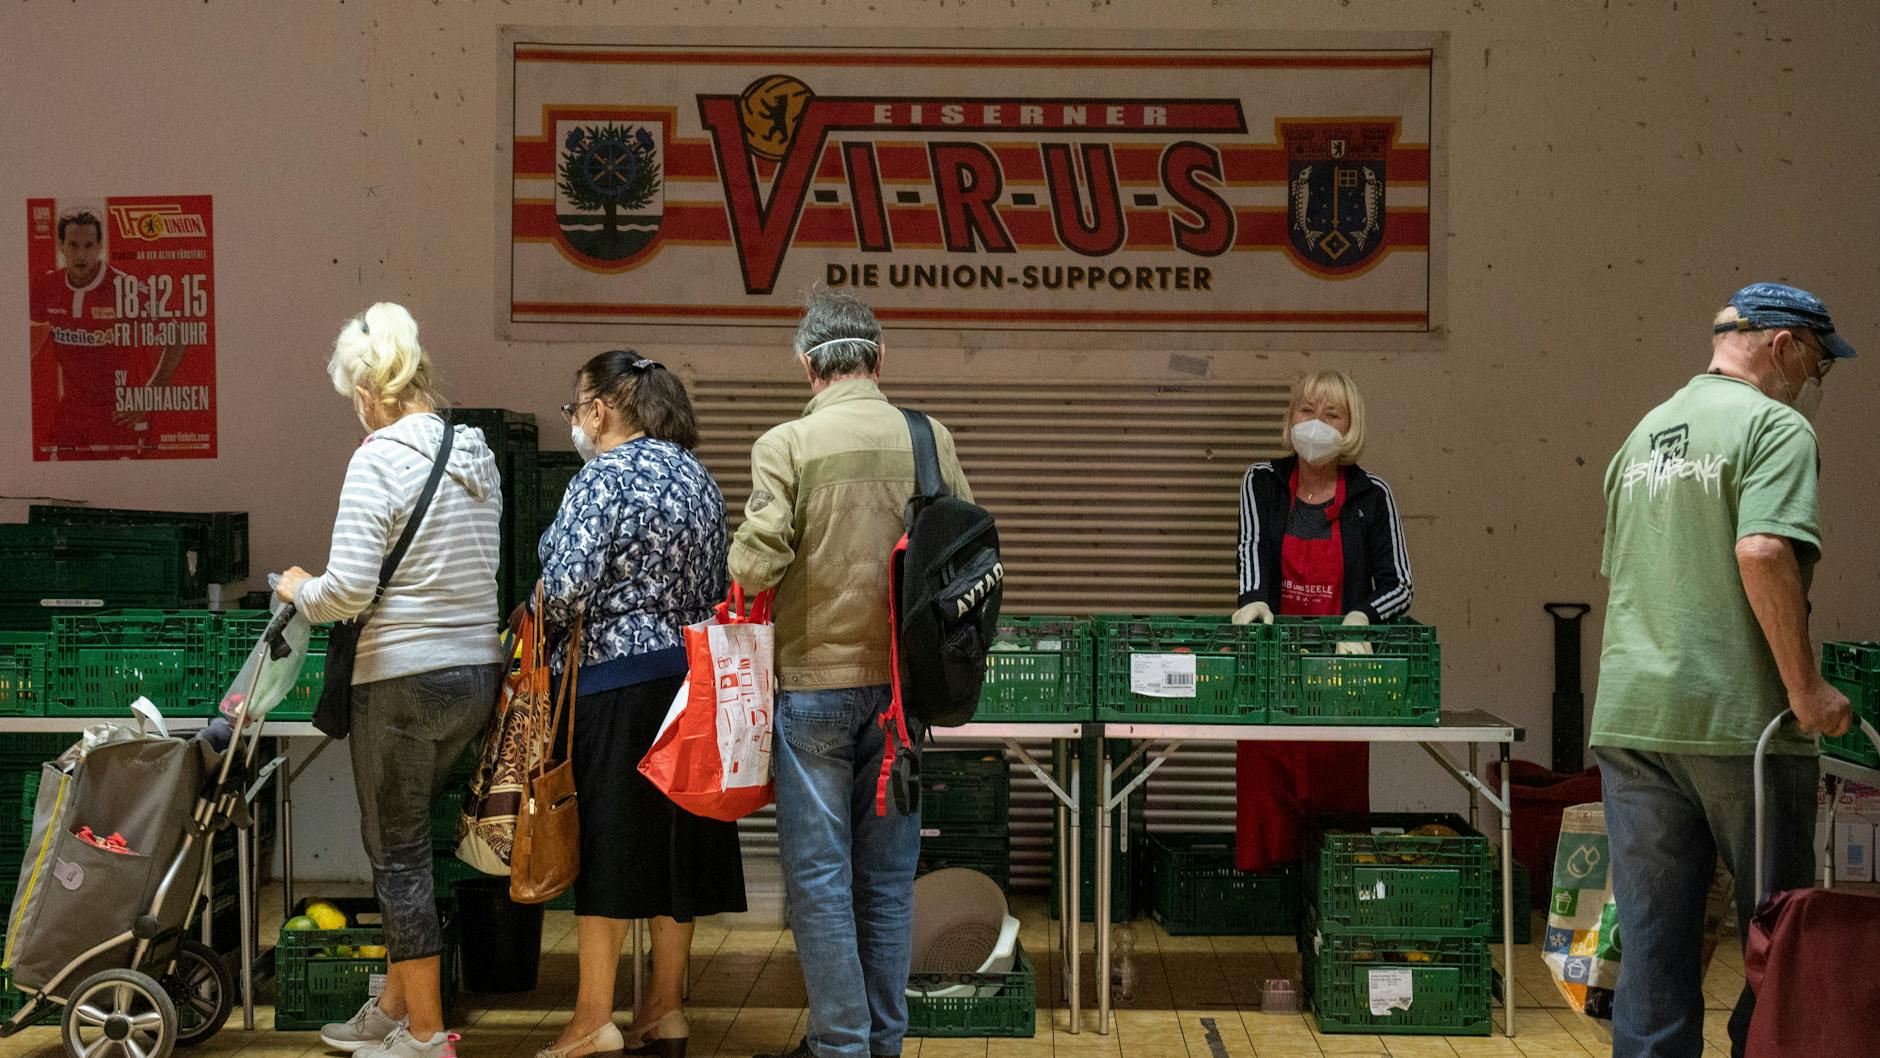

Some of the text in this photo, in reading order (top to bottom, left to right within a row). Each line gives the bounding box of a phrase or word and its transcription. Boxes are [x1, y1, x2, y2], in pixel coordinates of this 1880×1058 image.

[873, 104, 1167, 126] EISERNER
[696, 93, 1237, 295] V-I-R-U-S
[163, 218, 202, 234] UNION
[826, 263, 1213, 291] DIE UNION-SUPPORTER
[113, 273, 208, 319] 18.12.15
[114, 321, 208, 347] FR 18.30 UHR
[115, 369, 128, 386] SV
[115, 385, 209, 412] SANDHAUSEN
[1305, 584, 1333, 594] SEELE
